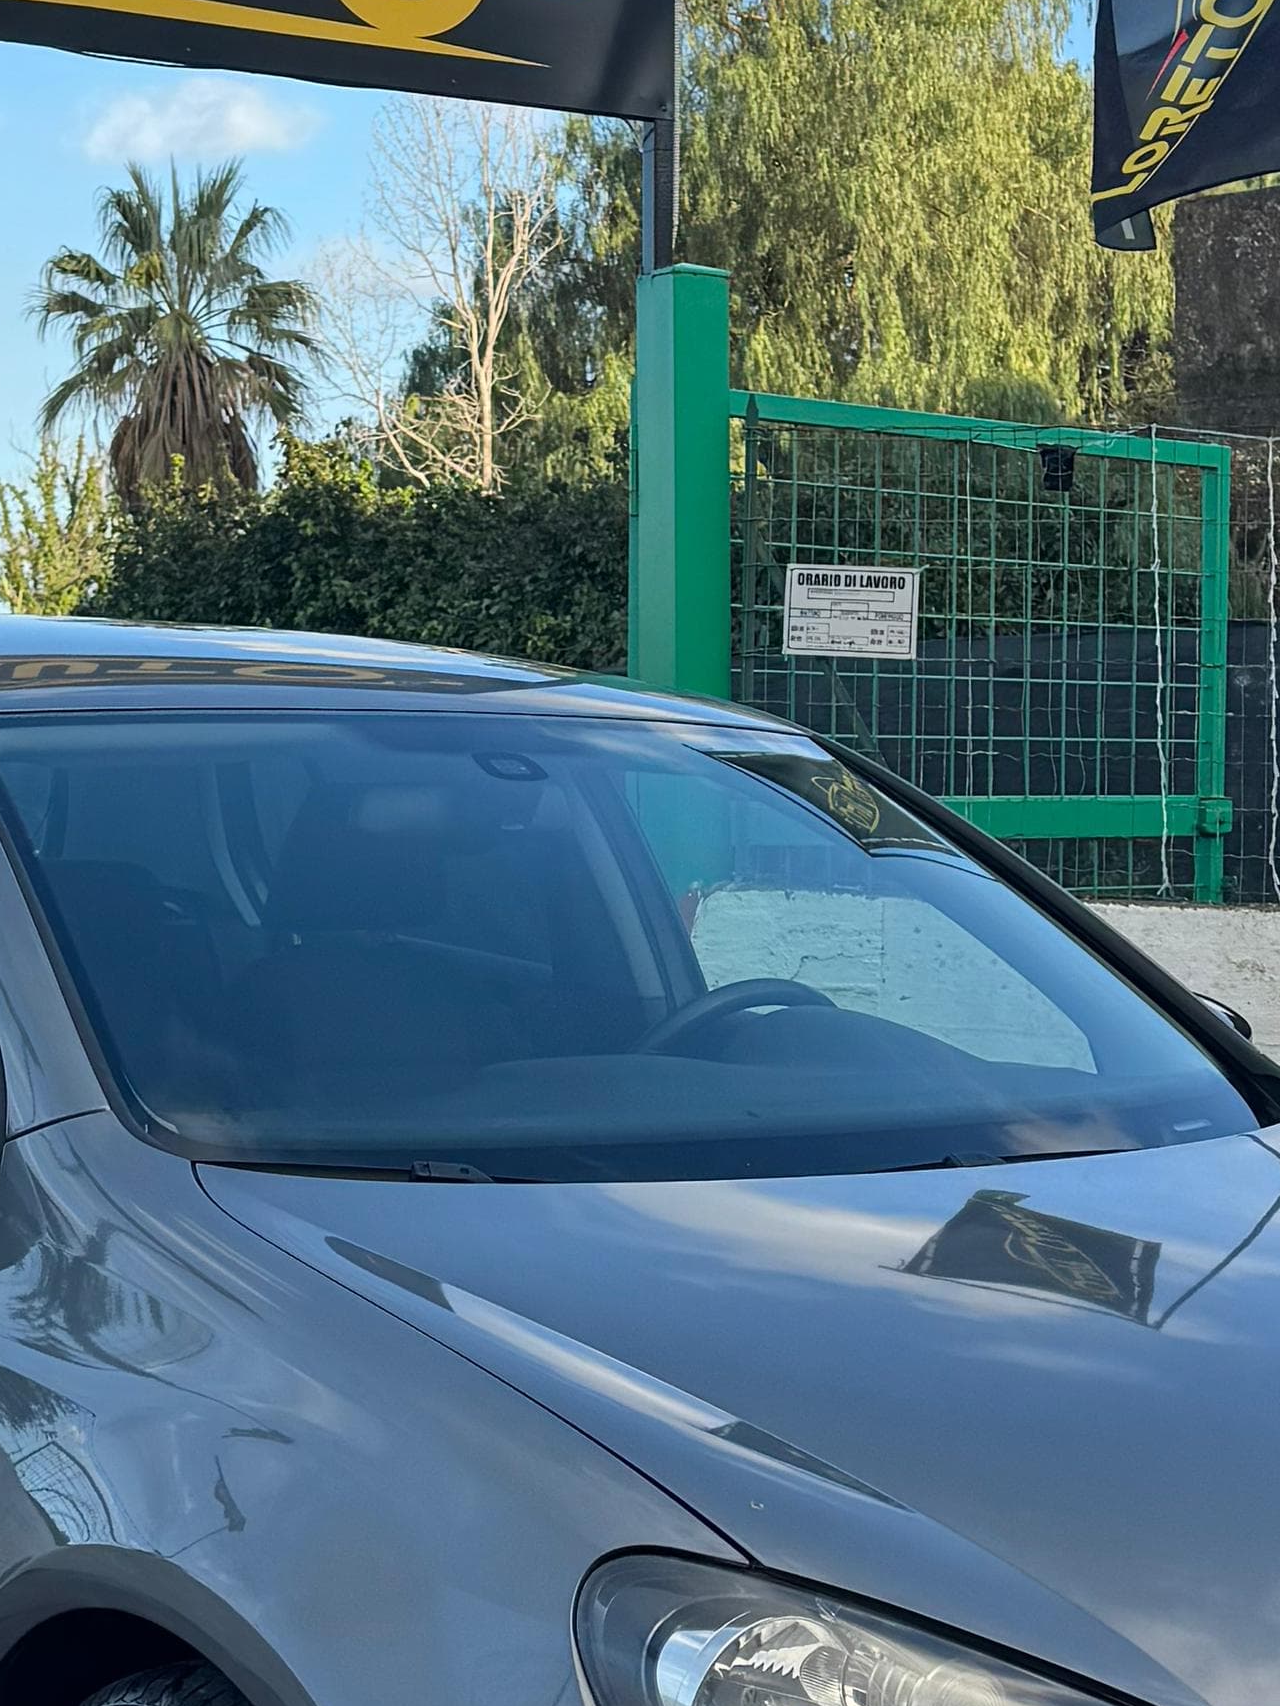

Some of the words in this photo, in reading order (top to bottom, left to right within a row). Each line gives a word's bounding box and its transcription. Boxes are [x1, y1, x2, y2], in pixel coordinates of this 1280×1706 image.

[797, 572, 841, 587] ORARIO
[844, 574, 857, 587] DI
[860, 574, 906, 590] LAVORO
